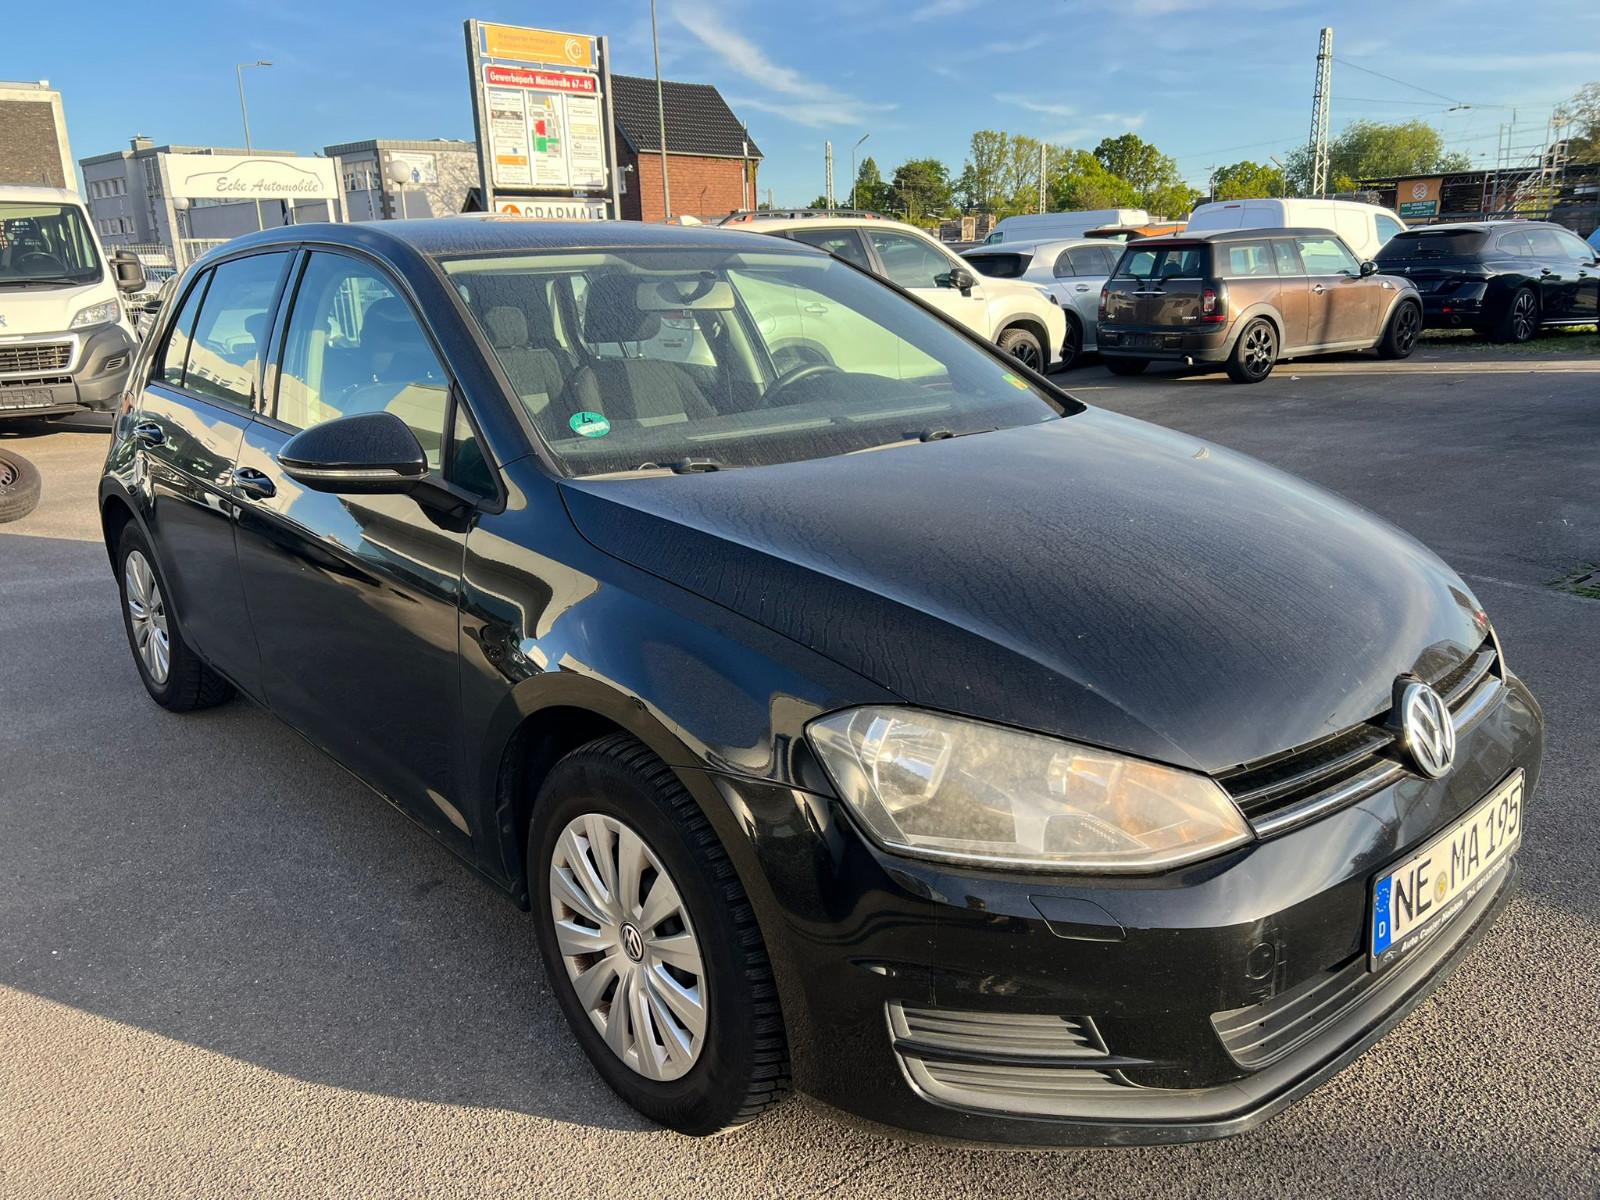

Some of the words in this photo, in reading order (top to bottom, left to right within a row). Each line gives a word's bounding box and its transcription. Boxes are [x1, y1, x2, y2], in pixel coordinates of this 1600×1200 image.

[490, 72, 534, 85] Gewerbepark
[536, 76, 570, 87] Mainstraße
[216, 176, 247, 192] Ecke
[251, 178, 318, 192] Automobile
[1394, 858, 1432, 931] NE
[1450, 823, 1480, 890] MA
[1485, 787, 1521, 860] 195
[1379, 921, 1386, 938] D
